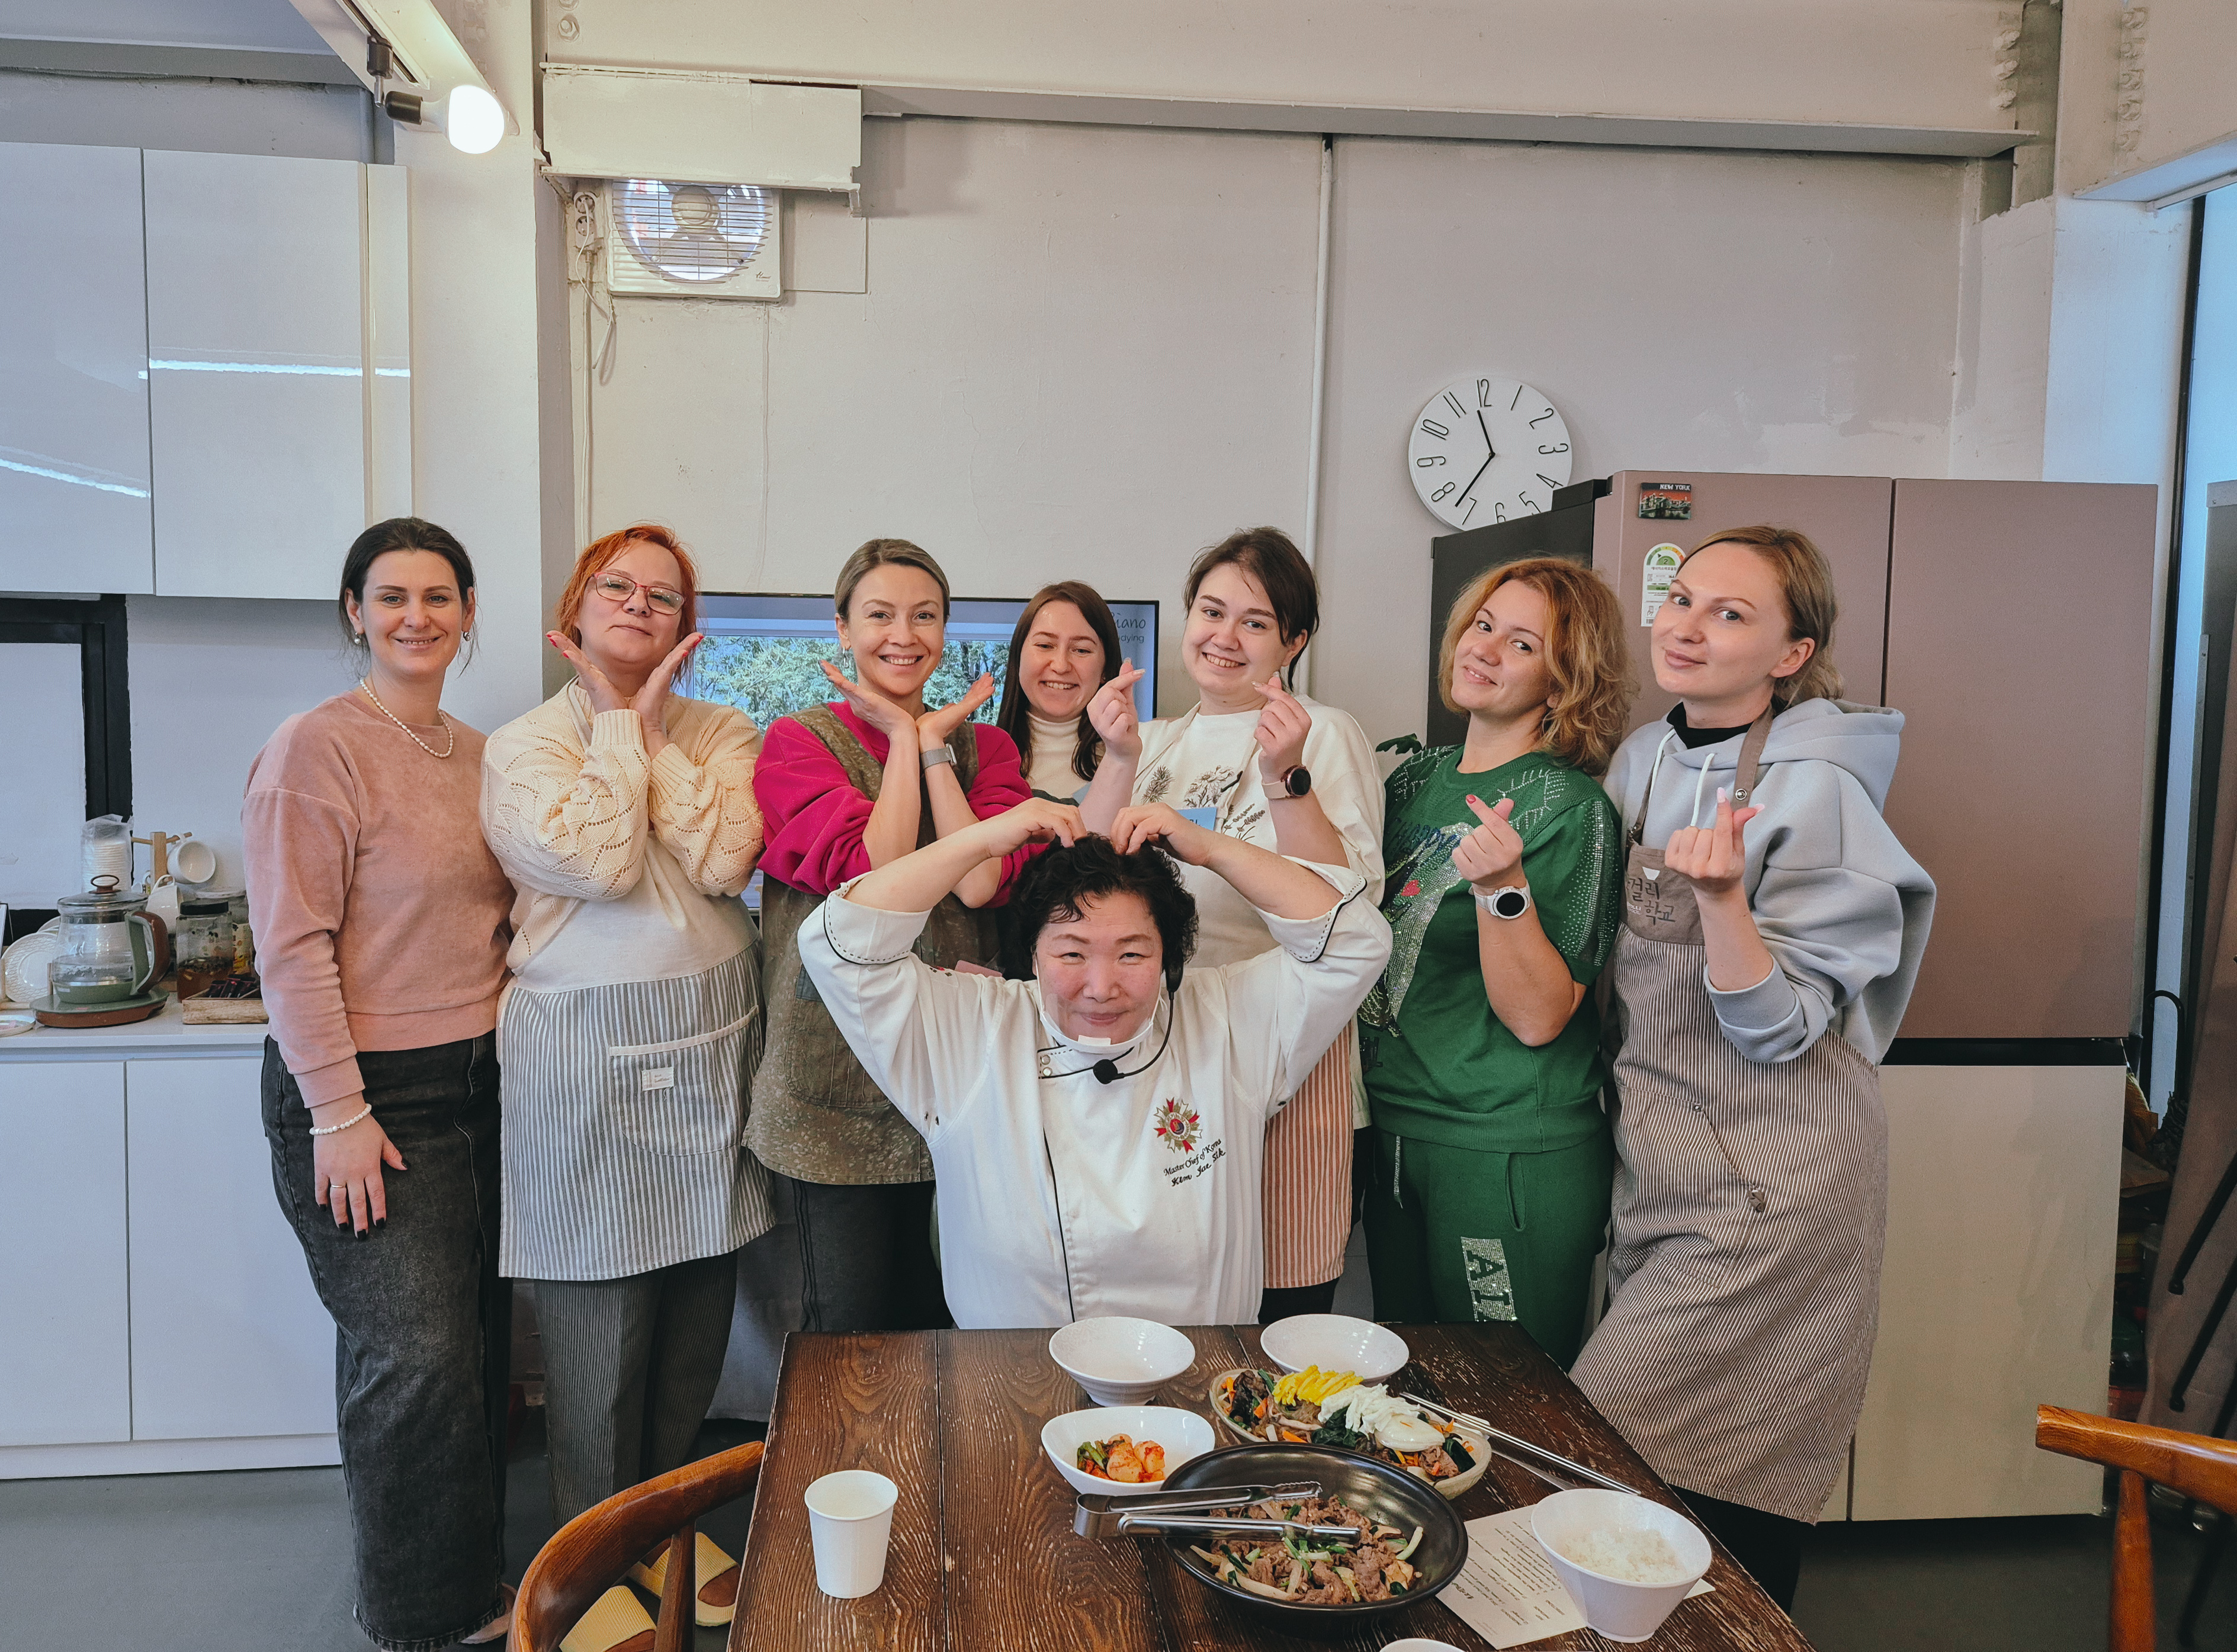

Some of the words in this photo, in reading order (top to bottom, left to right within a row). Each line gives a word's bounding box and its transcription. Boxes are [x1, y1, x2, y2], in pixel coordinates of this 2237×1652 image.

[1477, 378, 1493, 407] 12
[1510, 385, 1523, 411] 1
[1442, 391, 1466, 418] 11
[1420, 419, 1449, 441] 10
[1528, 407, 1554, 430] 2
[1538, 443, 1569, 454] 3
[1416, 455, 1446, 468] 9
[1430, 481, 1456, 502] 8
[1536, 473, 1564, 488] 4
[1462, 497, 1477, 525] 7
[1518, 491, 1541, 516] 5
[1119, 634, 1144, 644] dying
[1644, 900, 1676, 925] 학교
[1163, 1163, 1185, 1177] Master
[1185, 1153, 1199, 1168] Chef
[1199, 1148, 1206, 1161] of
[1212, 1148, 1226, 1163] Sik
